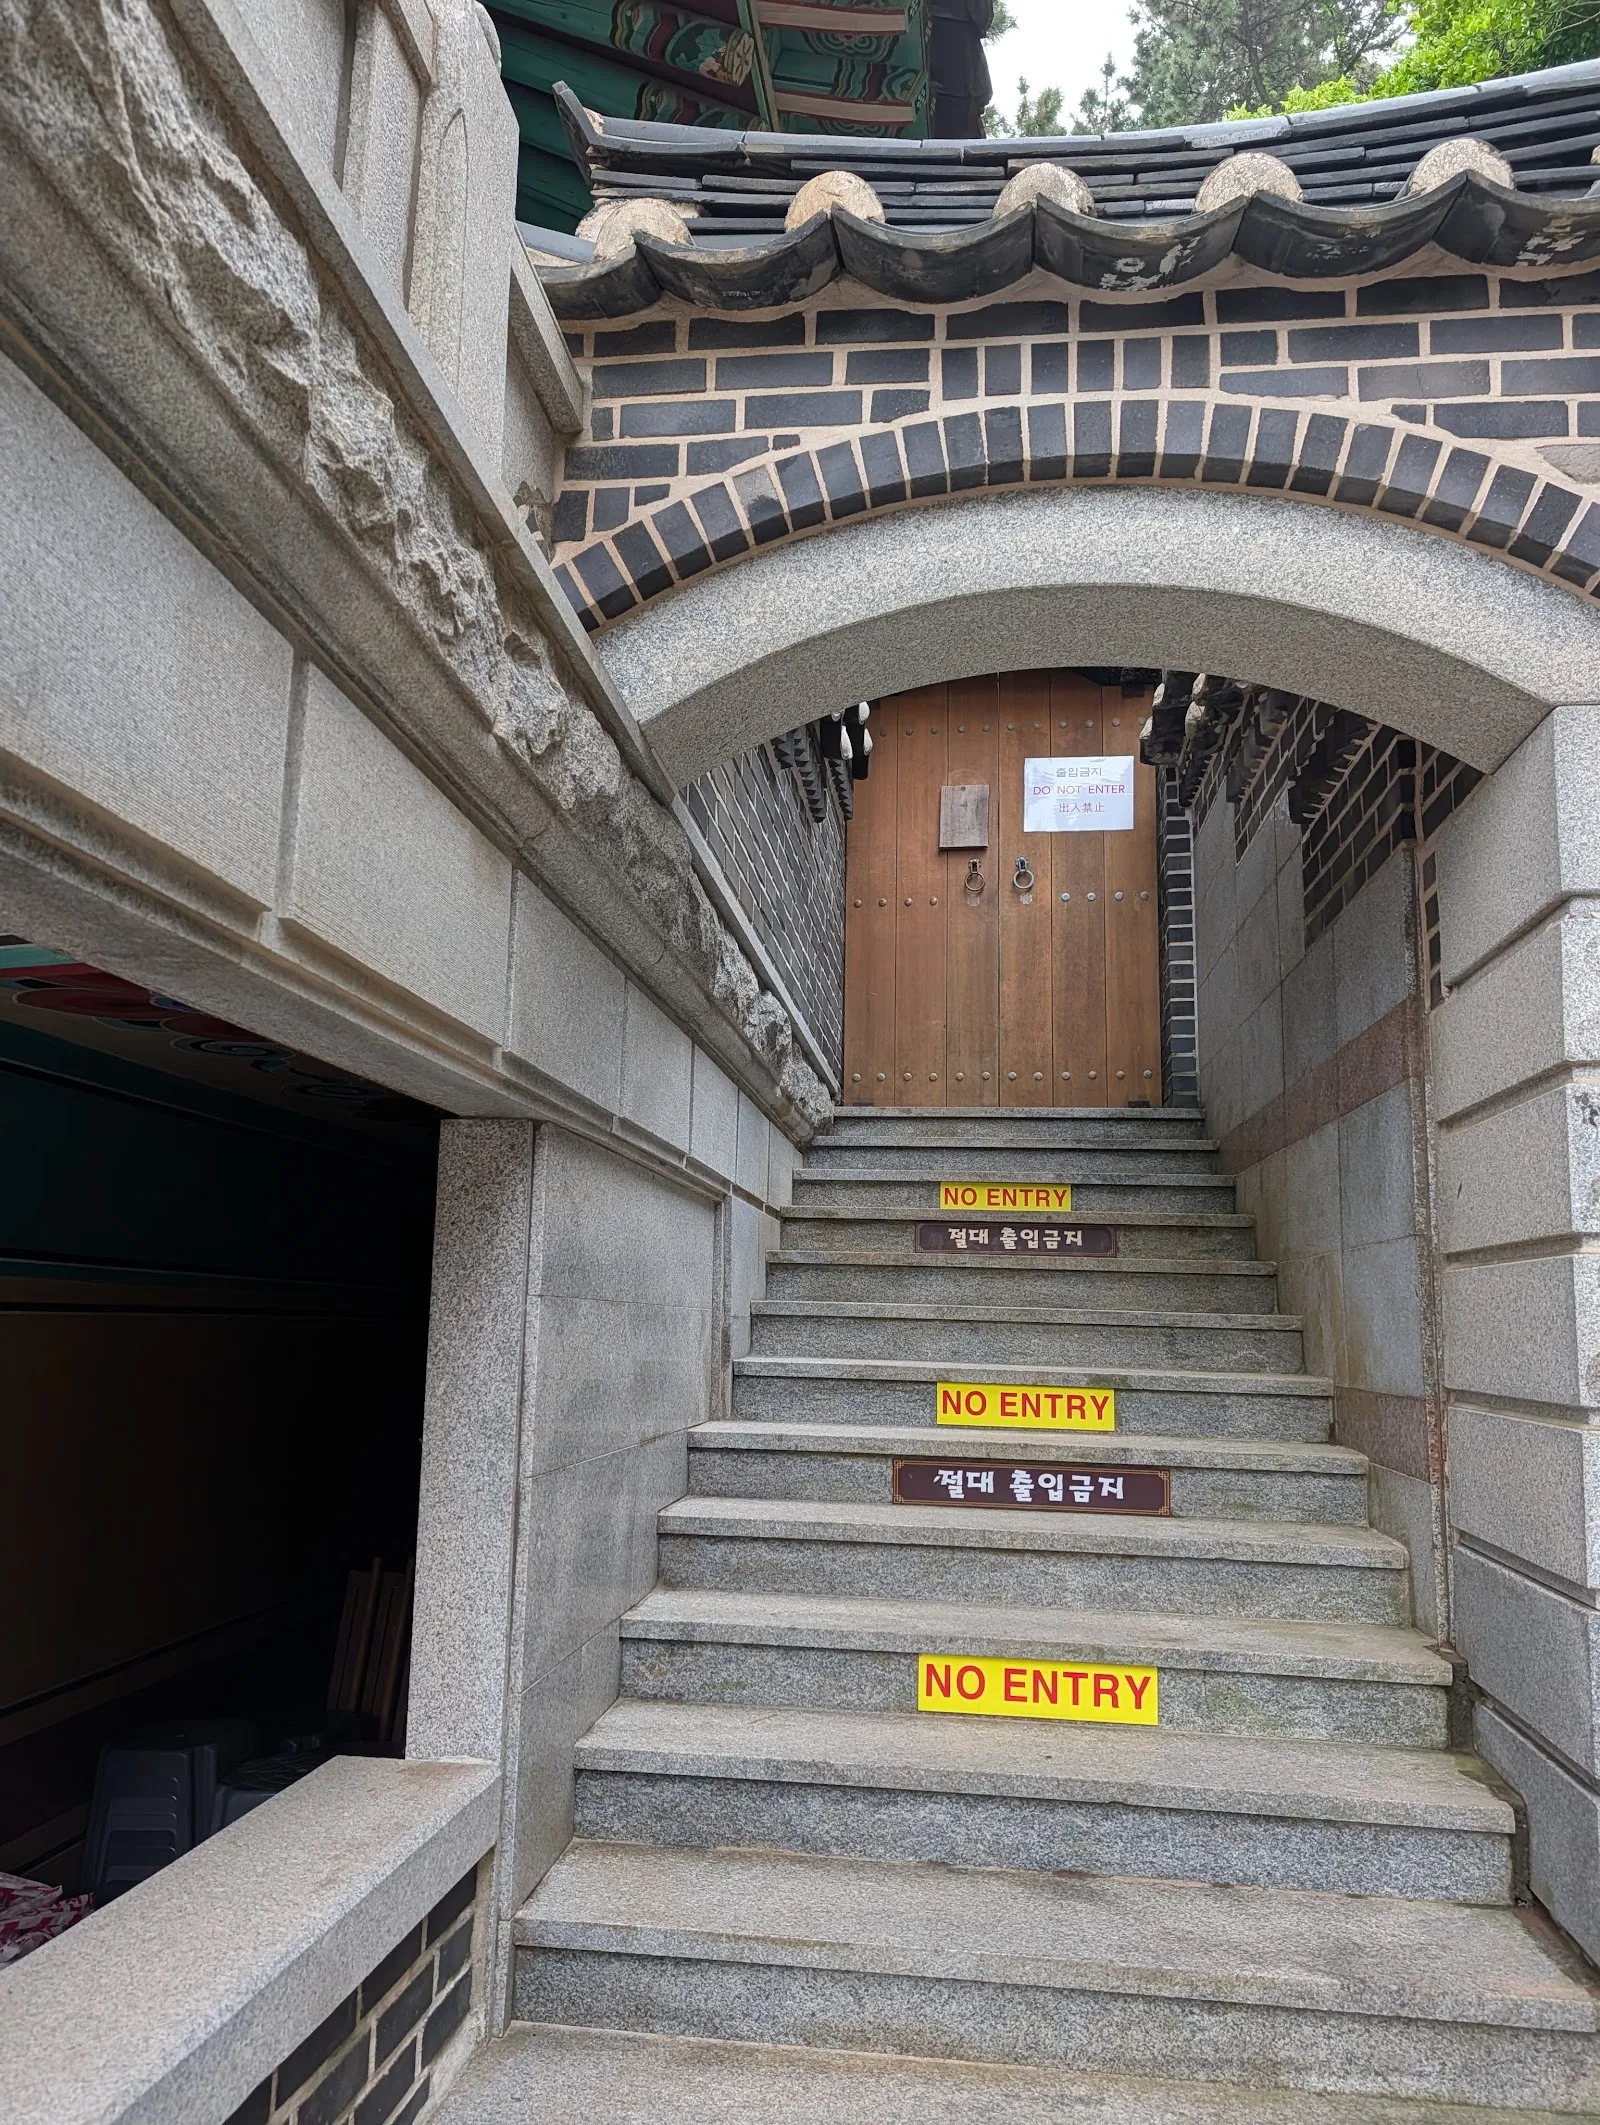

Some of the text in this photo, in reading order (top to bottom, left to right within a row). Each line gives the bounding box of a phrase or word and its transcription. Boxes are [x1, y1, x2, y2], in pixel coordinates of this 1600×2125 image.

[1056, 767, 1102, 778] 출입금지
[1033, 784, 1125, 795] DO NOT ENTER
[1059, 801, 1105, 813] 出入禁止
[944, 1187, 1068, 1208] NO ENTRY
[948, 1227, 1083, 1250] 절대 출입금지
[942, 1390, 1110, 1421] NO ENTRY
[933, 1469, 1124, 1503] 절대 출입금지
[925, 1663, 1151, 1710] NO ENTRY
